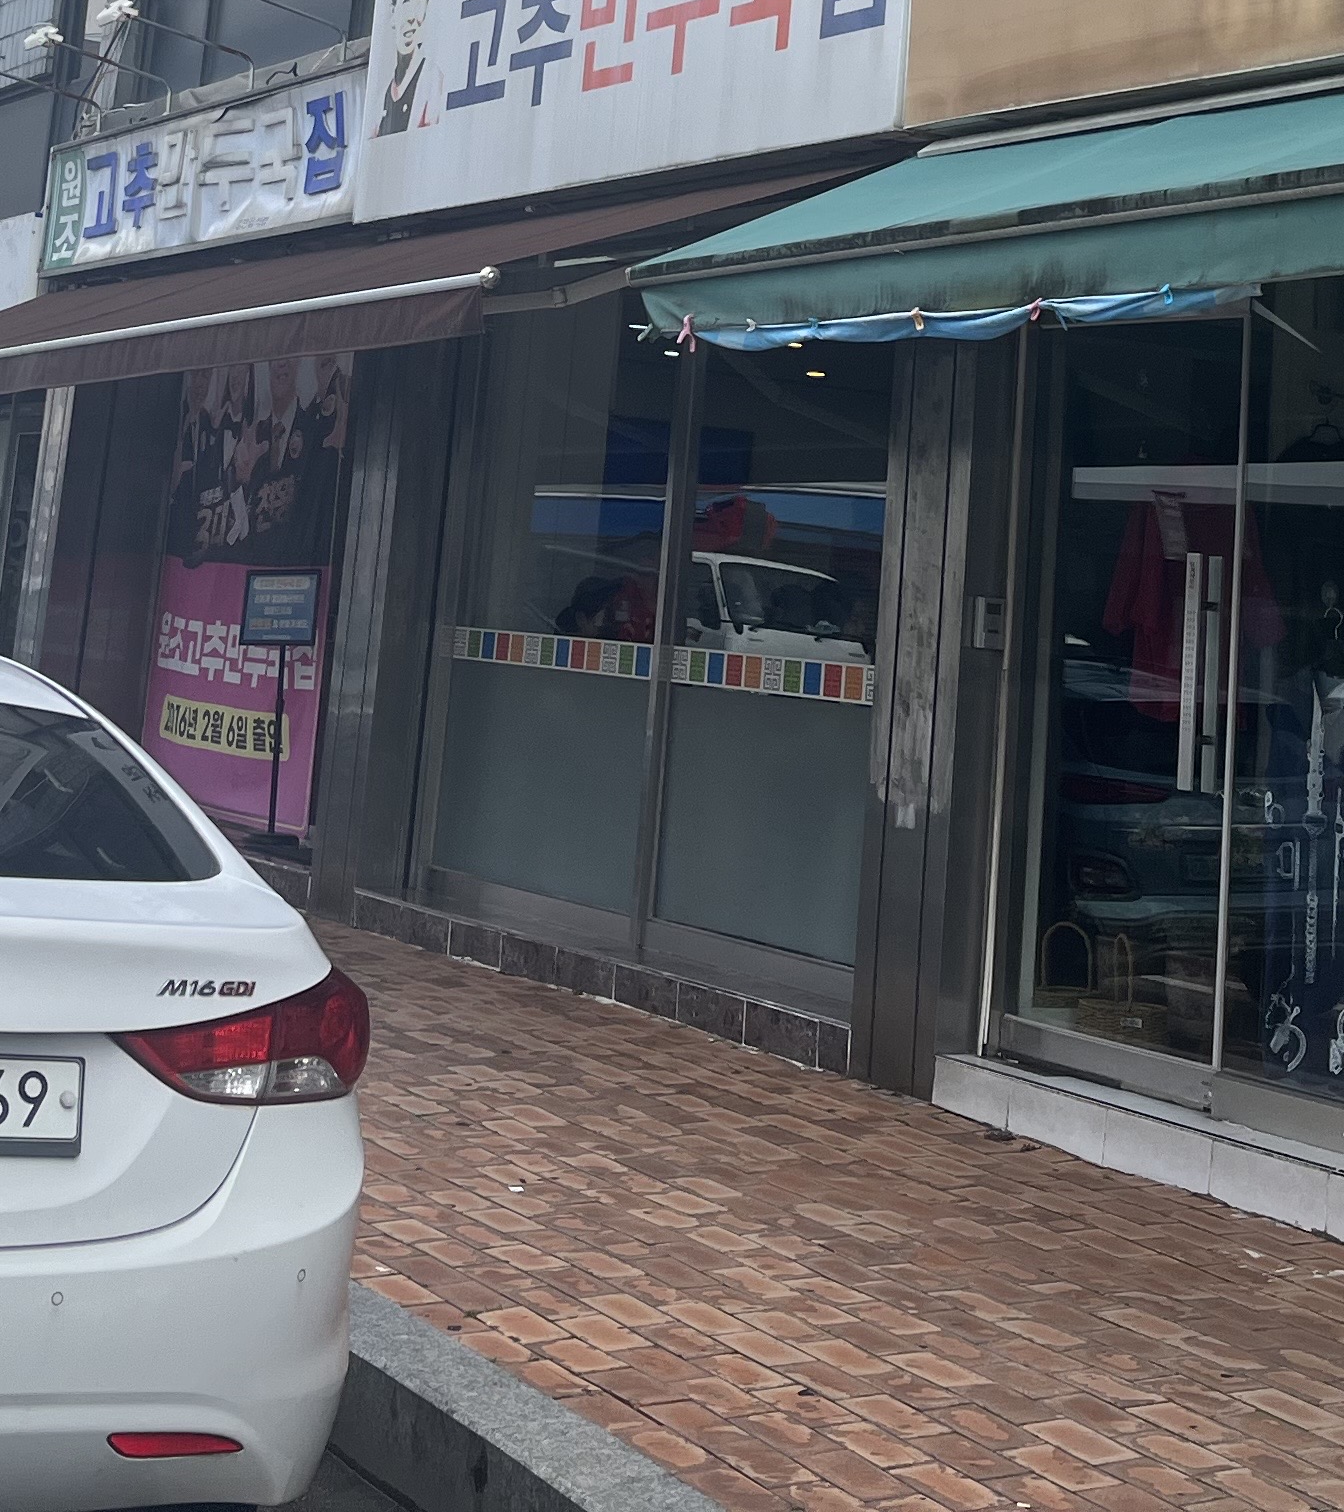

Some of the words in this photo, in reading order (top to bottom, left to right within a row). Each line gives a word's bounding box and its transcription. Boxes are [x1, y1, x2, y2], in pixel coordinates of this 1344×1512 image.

[51, 158, 85, 262] 원조
[200, 709, 225, 745] 2월
[226, 715, 249, 751] 6일
[156, 977, 217, 999] M16
[217, 979, 256, 999] GDI
